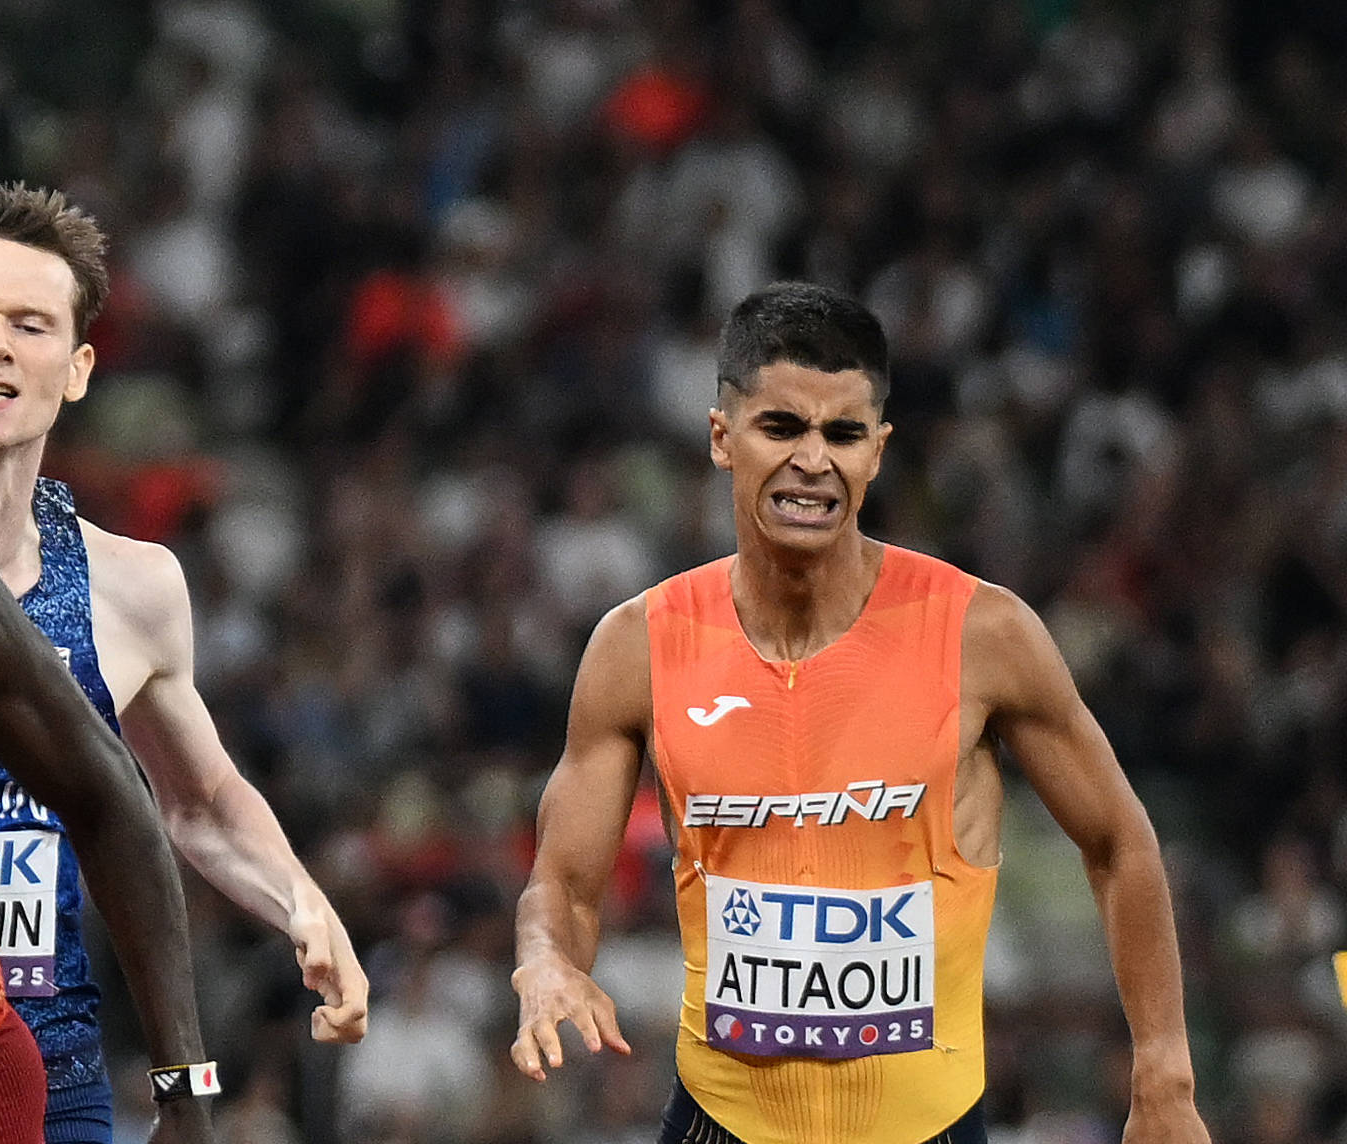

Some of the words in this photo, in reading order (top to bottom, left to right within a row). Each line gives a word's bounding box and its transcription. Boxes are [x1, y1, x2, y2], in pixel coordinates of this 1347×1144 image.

[682, 779, 928, 828] ESPAÑA
[762, 892, 917, 944] TDK
[716, 952, 921, 1010] ATTAOUI
